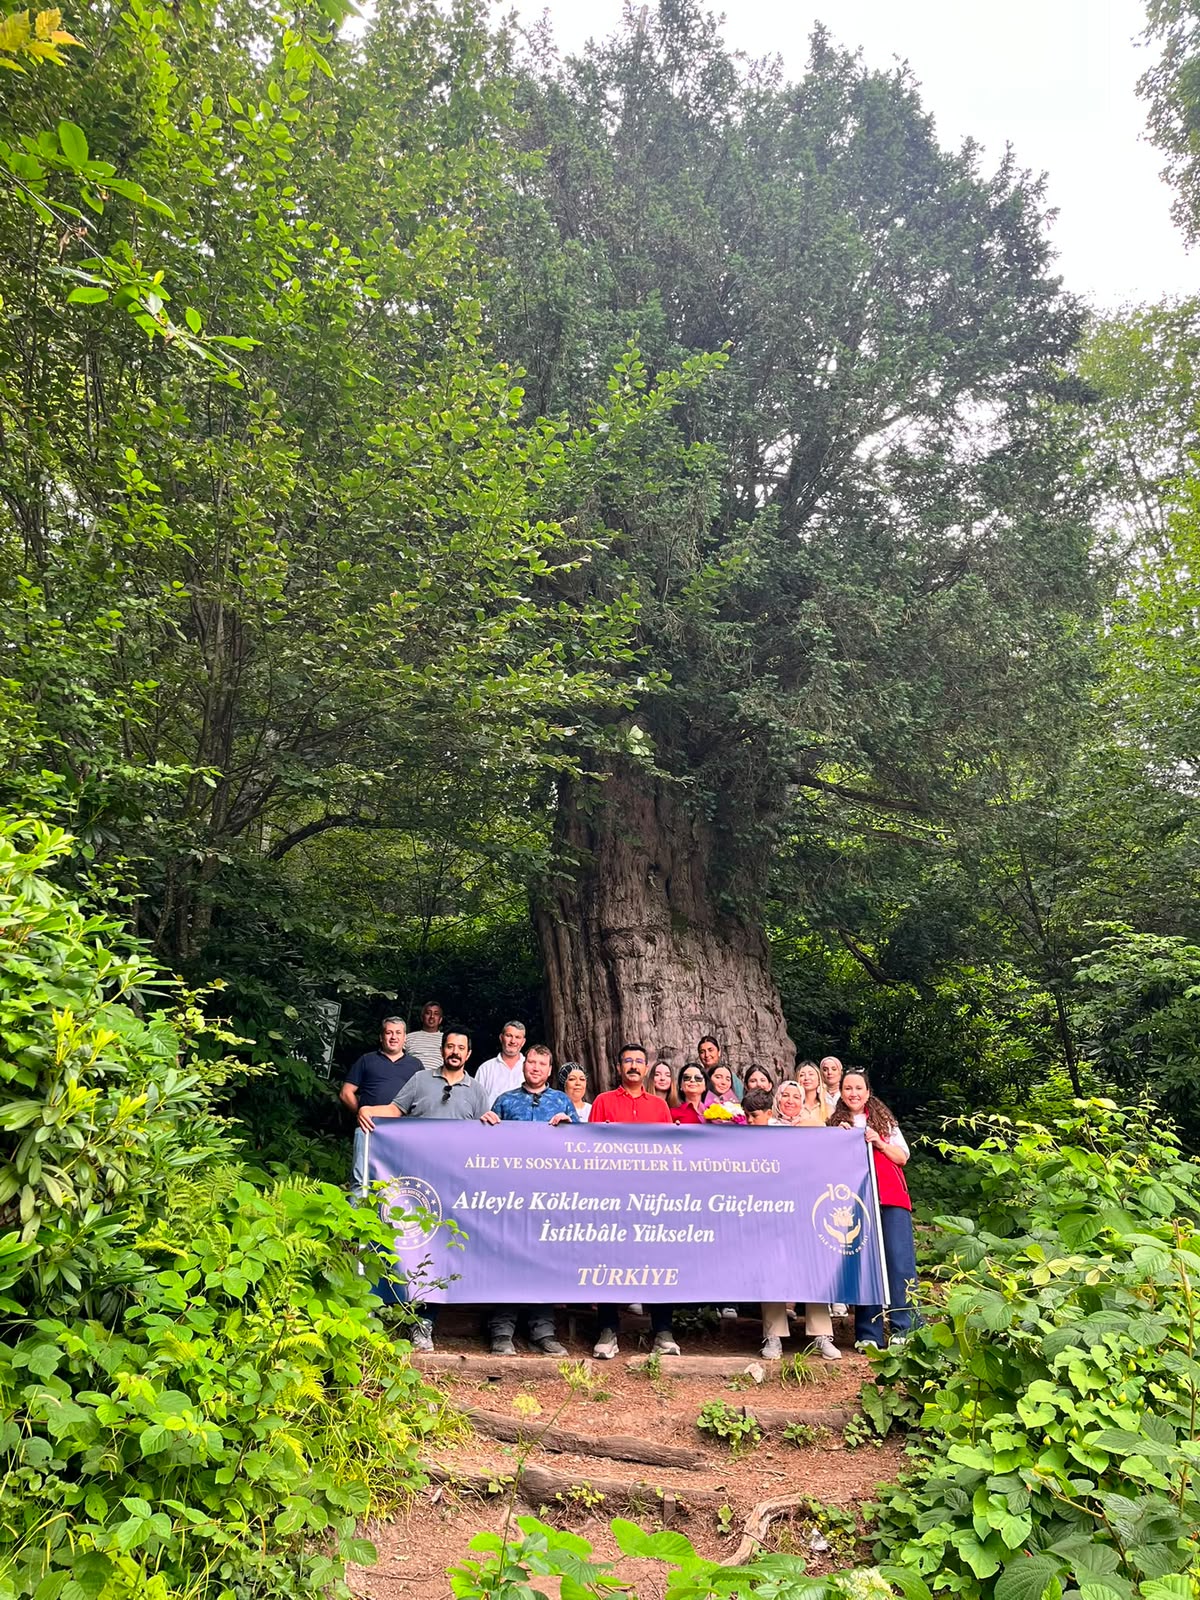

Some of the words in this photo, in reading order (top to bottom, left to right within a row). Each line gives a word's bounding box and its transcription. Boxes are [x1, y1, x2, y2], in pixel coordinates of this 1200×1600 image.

[564, 1141, 591, 1154] T.C.
[593, 1142, 683, 1154] ZONGULDAK
[464, 1154, 499, 1169] AİLE
[503, 1157, 522, 1169] VE
[525, 1157, 581, 1170] SOSYAL
[584, 1156, 668, 1171] HİZMETLER
[672, 1156, 687, 1172] İL
[689, 1157, 780, 1174] MÜDÜRLÜĞÜ
[452, 1191, 524, 1214] Aileyle
[529, 1192, 621, 1211] Köklenen
[626, 1192, 702, 1216] Nüfusla
[708, 1194, 795, 1217] Güçlenen
[539, 1219, 627, 1242] İstikbâle
[632, 1223, 715, 1242] Yükselen
[578, 1264, 679, 1286] TÜRKİYE
